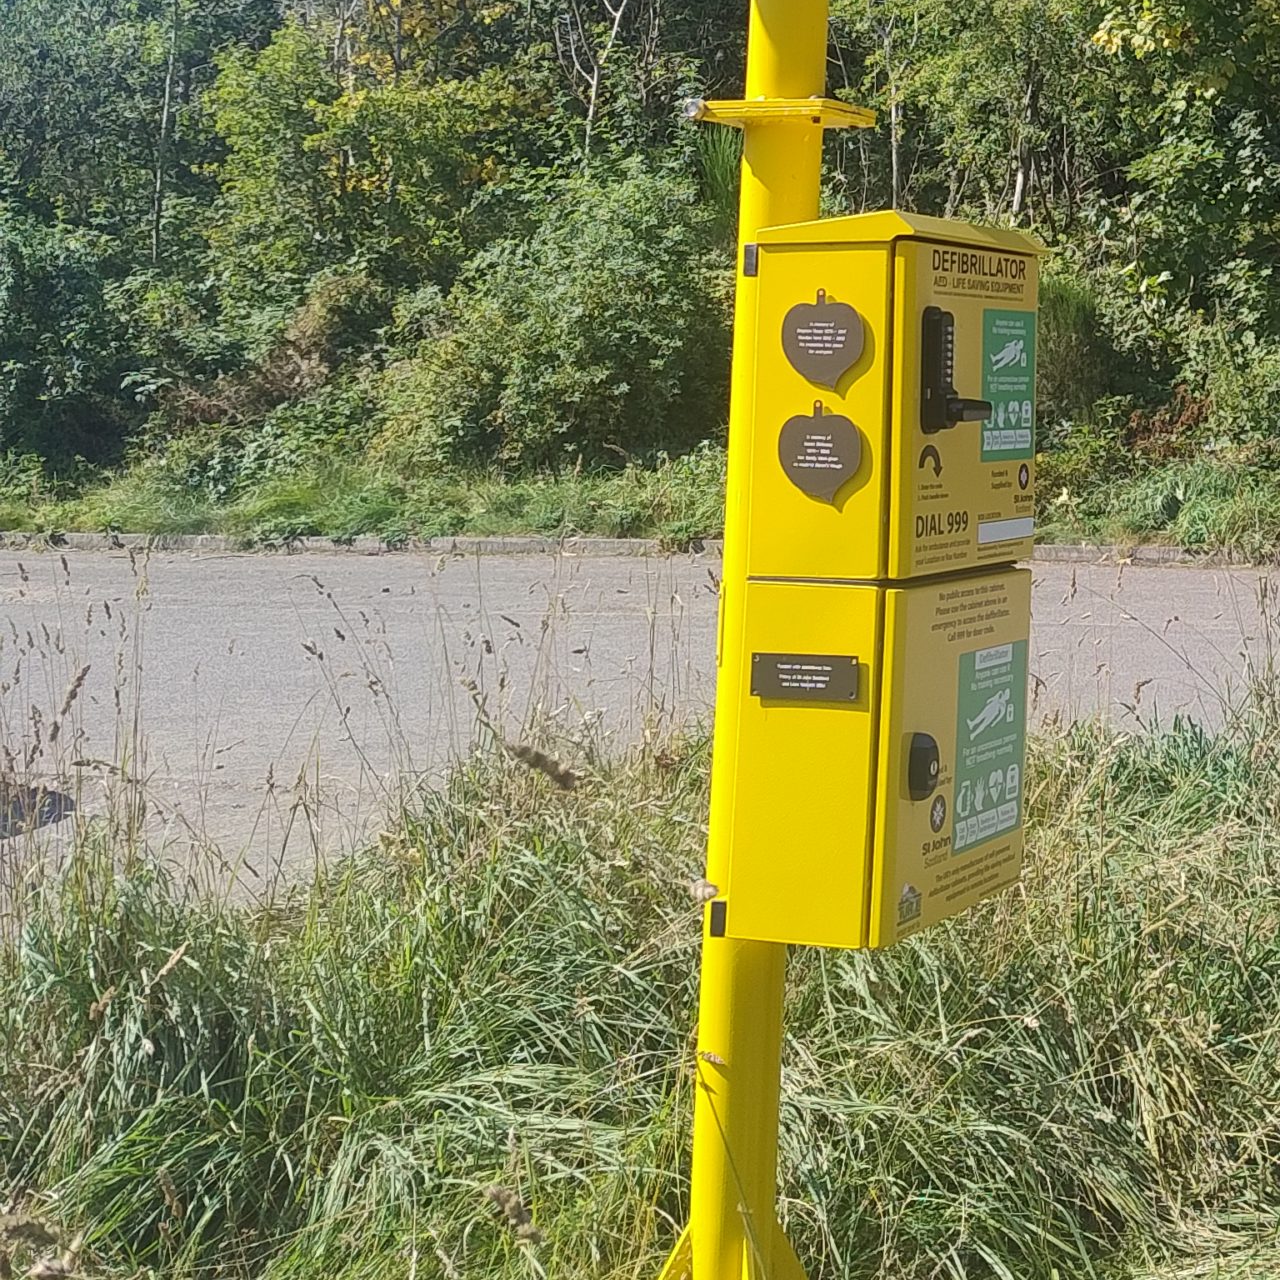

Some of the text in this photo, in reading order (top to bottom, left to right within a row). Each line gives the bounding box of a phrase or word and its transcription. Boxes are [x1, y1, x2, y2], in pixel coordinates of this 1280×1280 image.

[932, 249, 1026, 280] DEFIBRILLATOR
[952, 277, 966, 289] LIFE
[967, 279, 990, 291] SAVING
[991, 281, 1024, 294] EQUIPMENT
[916, 511, 968, 538] DIAL 999
[932, 836, 951, 851] John
